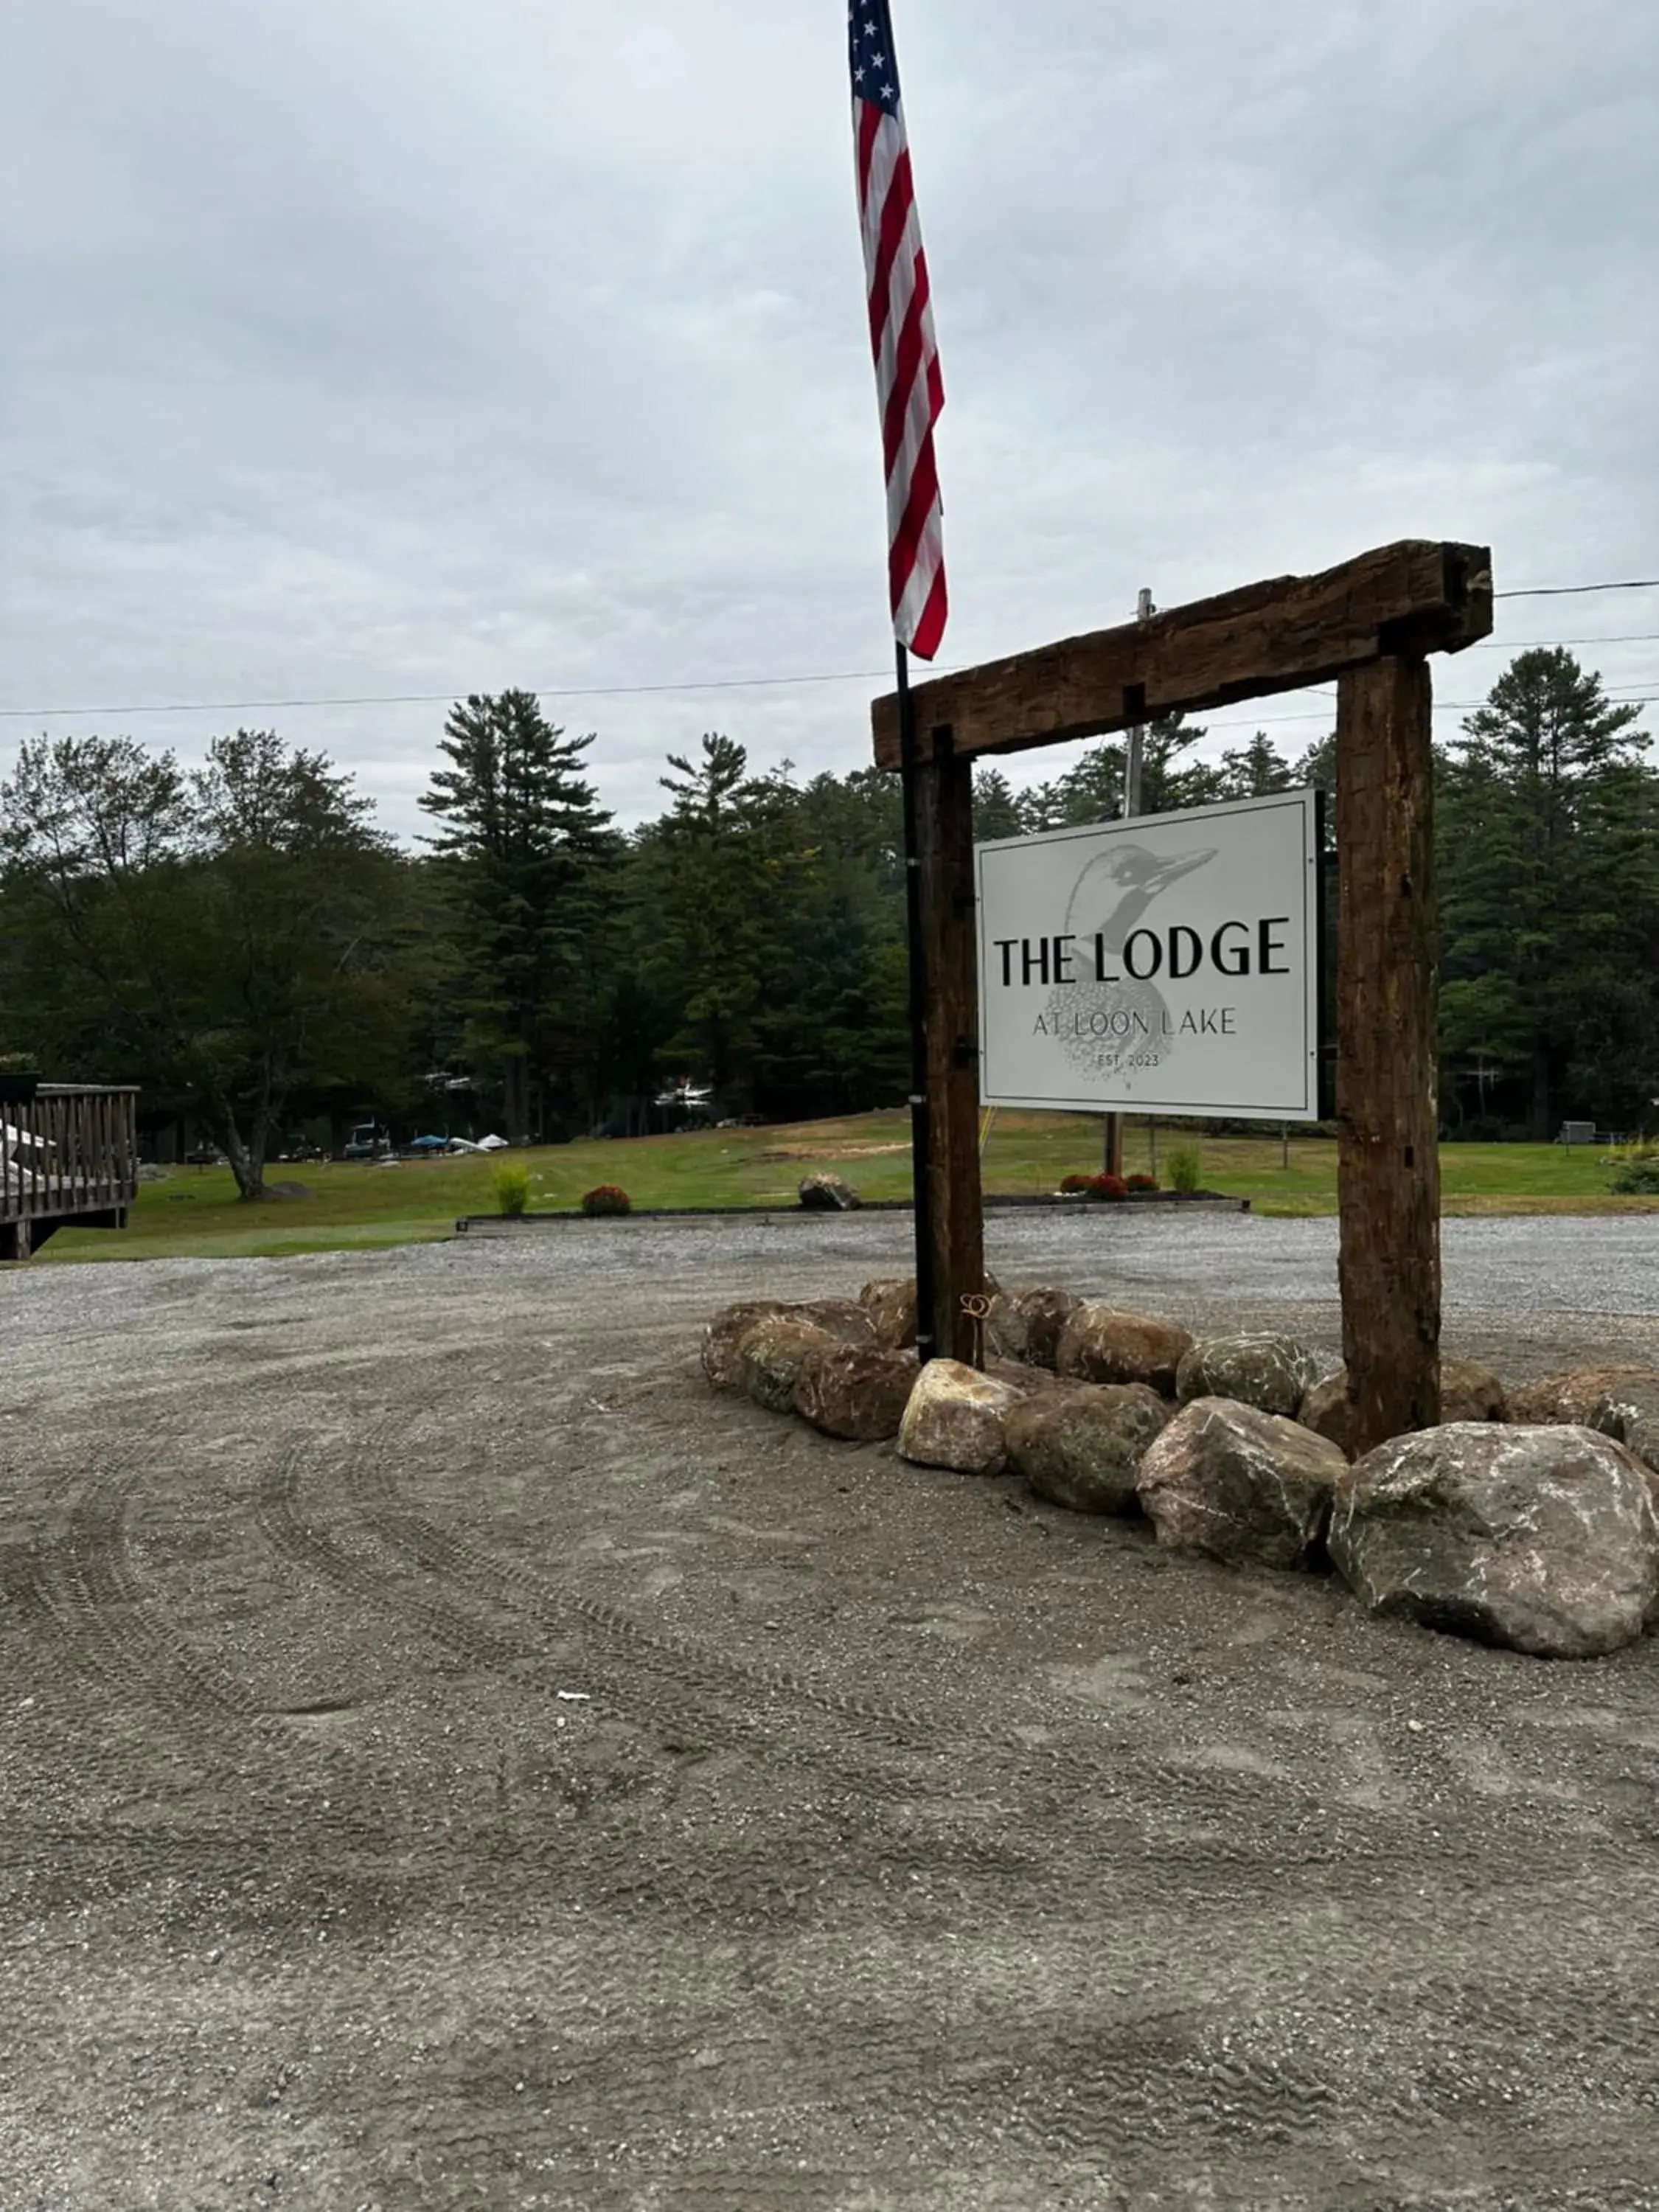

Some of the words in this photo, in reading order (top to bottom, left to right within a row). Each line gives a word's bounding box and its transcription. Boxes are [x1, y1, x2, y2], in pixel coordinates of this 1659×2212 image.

[993, 935, 1077, 987] THE
[1095, 917, 1290, 982] LODGE
[1033, 1012, 1062, 1035] AT
[1074, 1010, 1149, 1035] LOON
[1162, 1007, 1237, 1034] LAKE
[1128, 1054, 1158, 1067] 2023
